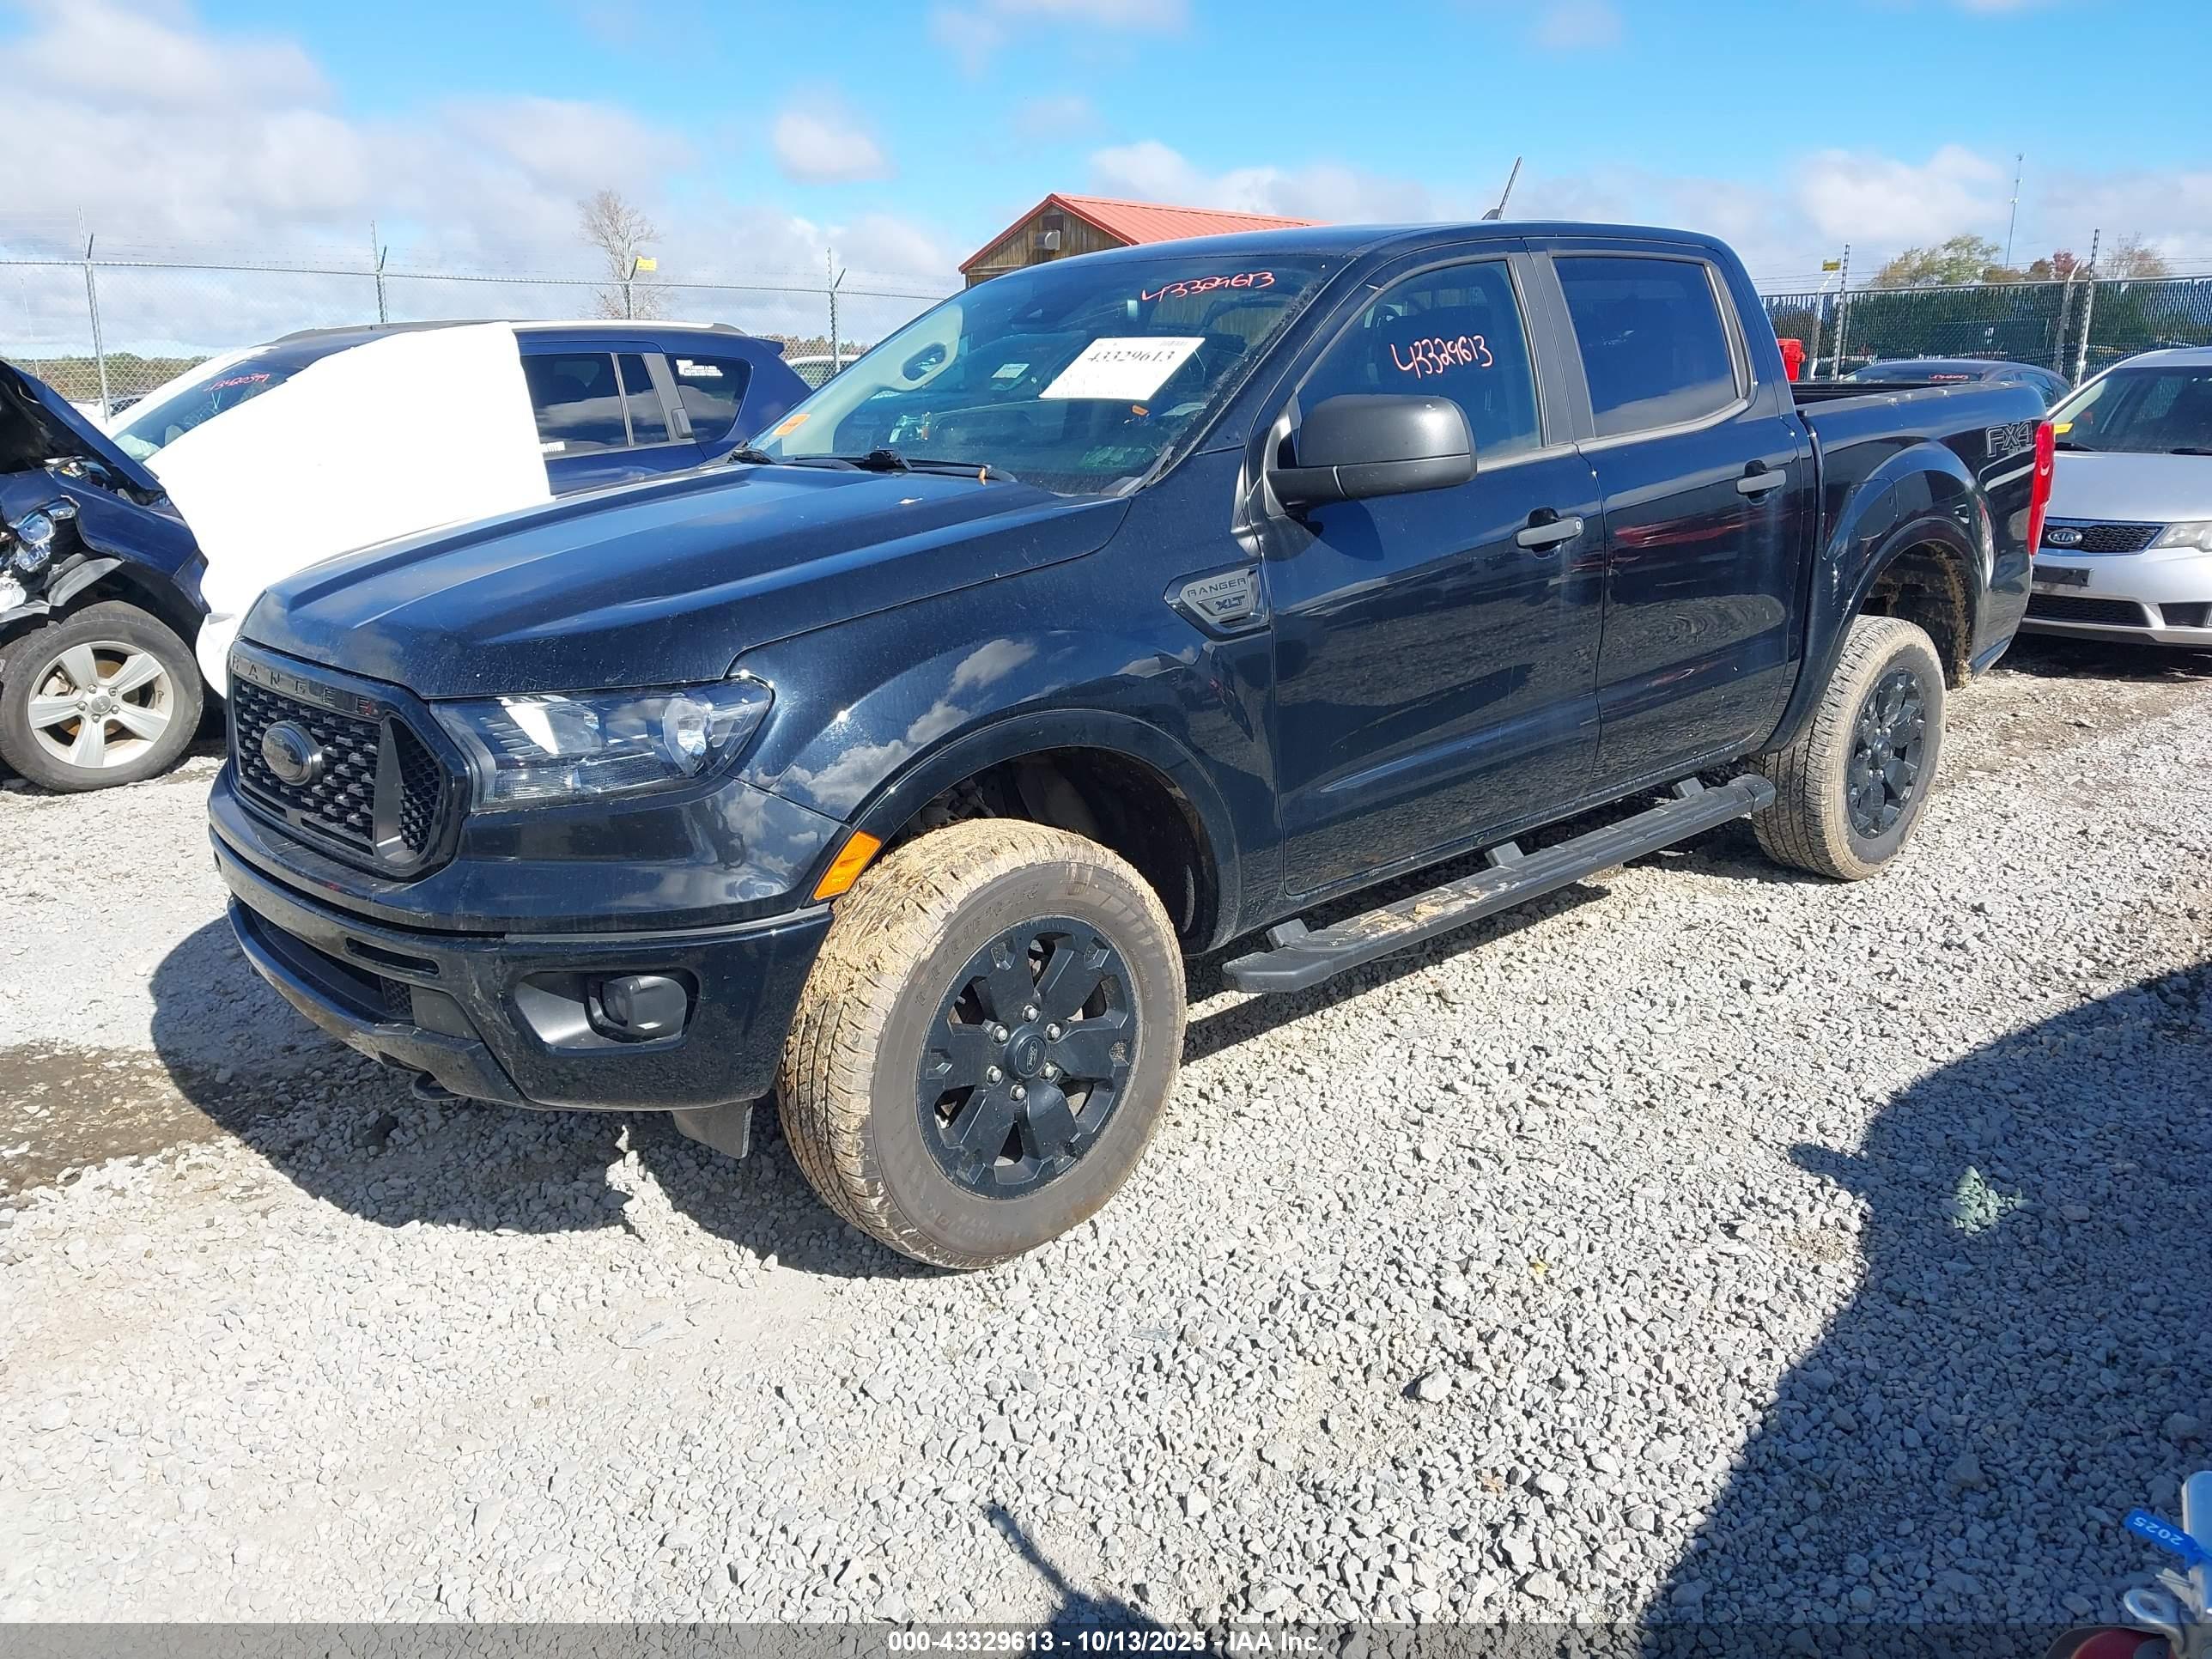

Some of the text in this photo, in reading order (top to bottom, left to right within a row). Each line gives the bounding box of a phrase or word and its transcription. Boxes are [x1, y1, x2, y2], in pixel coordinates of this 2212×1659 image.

[1141, 271, 1276, 303] 43329613
[1088, 350, 1176, 362] 43329613
[1390, 334, 1493, 379] 43329613
[1985, 420, 2033, 458] FX4
[1187, 577, 1247, 598] RANGER
[1215, 595, 1246, 611] XLT
[2133, 1516, 2184, 1546] 2025
